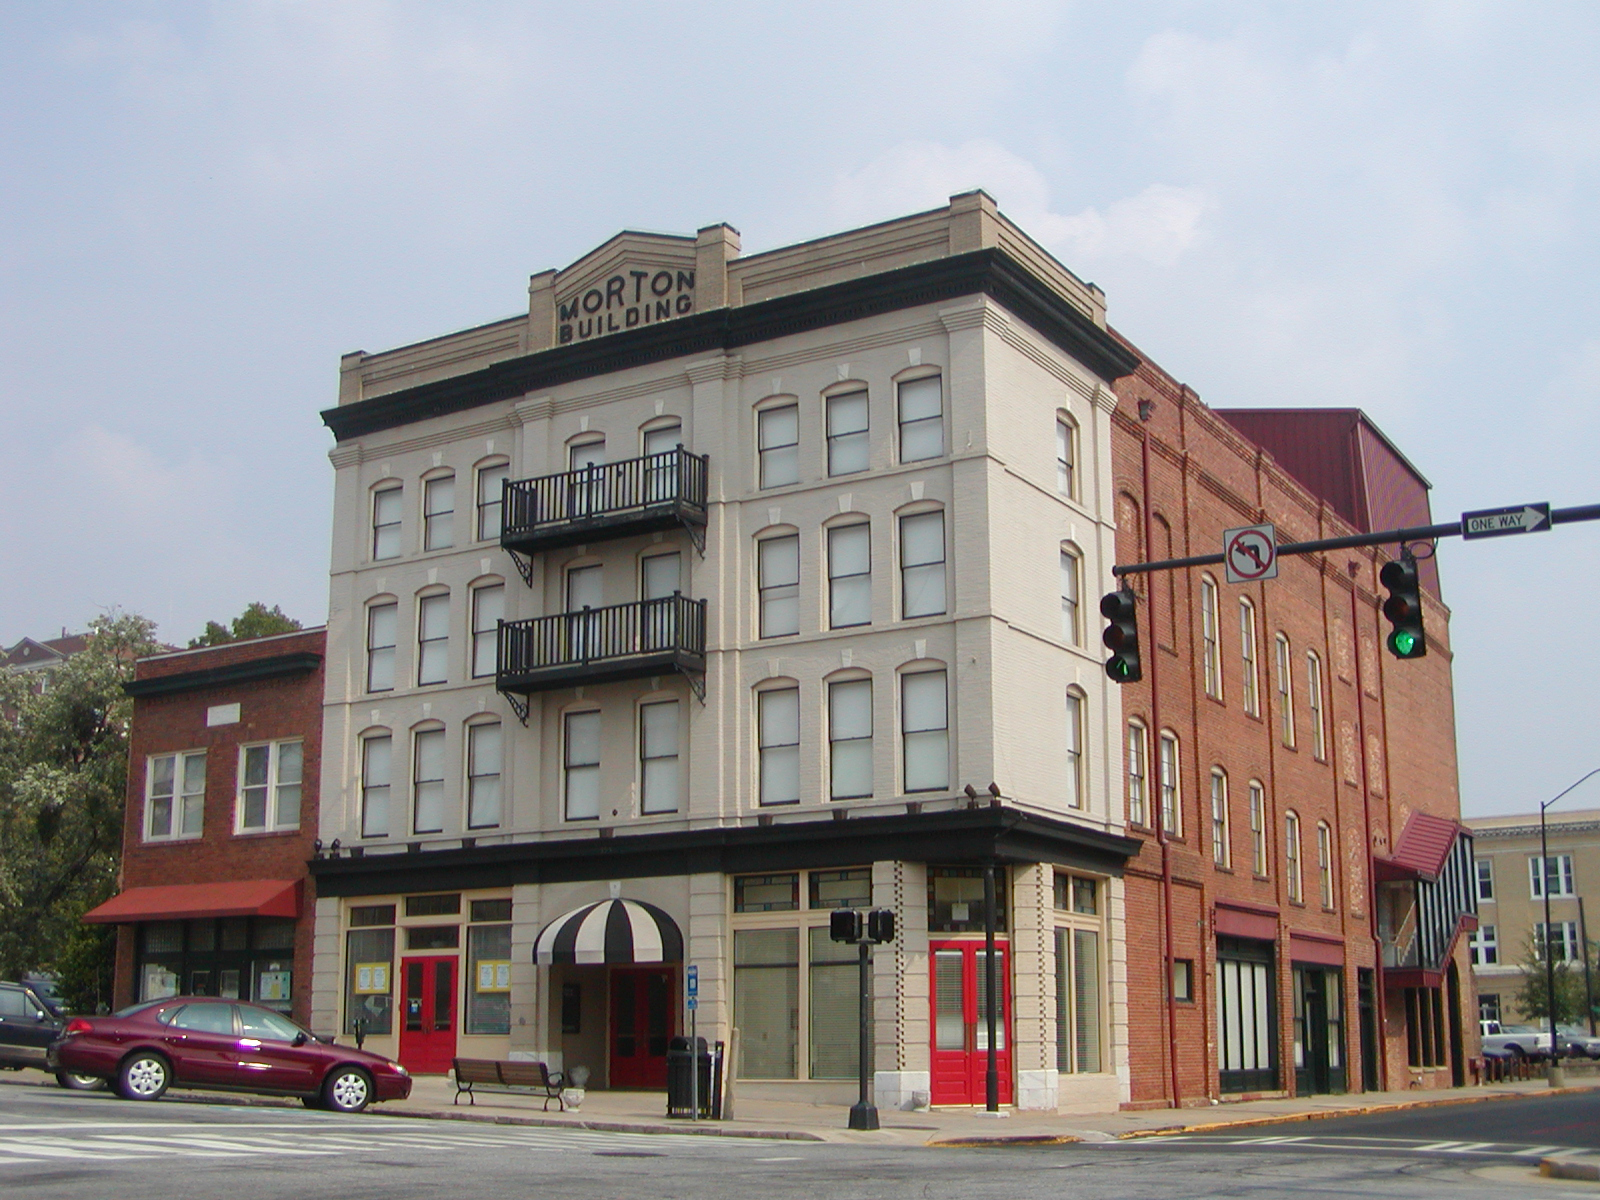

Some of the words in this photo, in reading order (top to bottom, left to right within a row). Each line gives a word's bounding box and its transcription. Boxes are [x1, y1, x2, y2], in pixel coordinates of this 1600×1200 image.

[560, 271, 694, 321] MORTON
[560, 294, 691, 343] BUILDING
[1471, 517, 1494, 530] ONE
[1499, 514, 1522, 527] WAY
